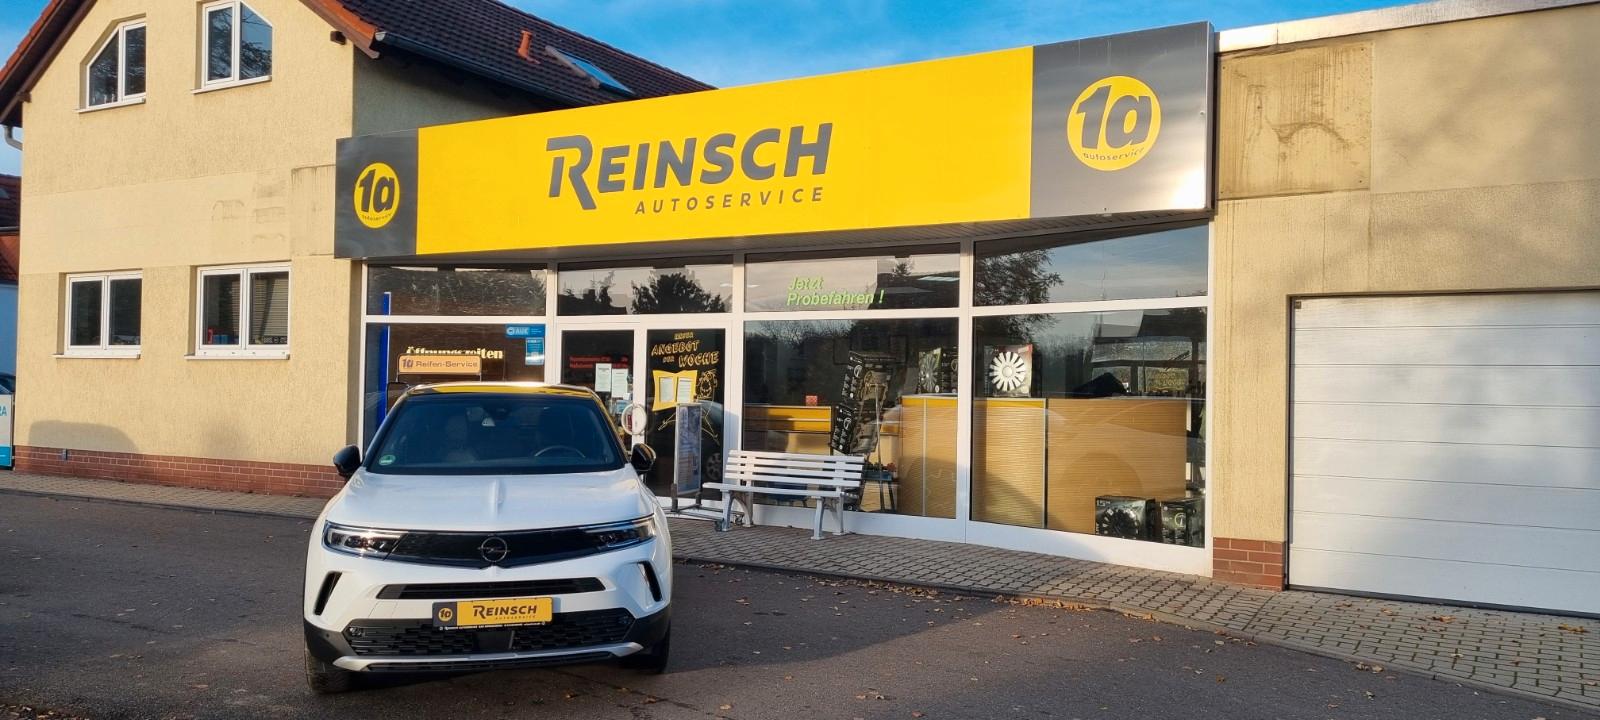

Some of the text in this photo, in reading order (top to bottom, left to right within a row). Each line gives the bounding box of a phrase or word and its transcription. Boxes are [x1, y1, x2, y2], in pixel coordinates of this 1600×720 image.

[1076, 84, 1153, 150] 1a
[545, 122, 833, 211] REINSCH
[358, 168, 396, 213] 1a
[634, 186, 824, 215] AUTOSERVICE
[789, 276, 824, 290] Jetzt
[786, 291, 875, 306] Probefahren
[651, 341, 700, 356] ANGEBOT
[678, 351, 719, 367] WOCHE
[473, 605, 538, 620] REINSCH
